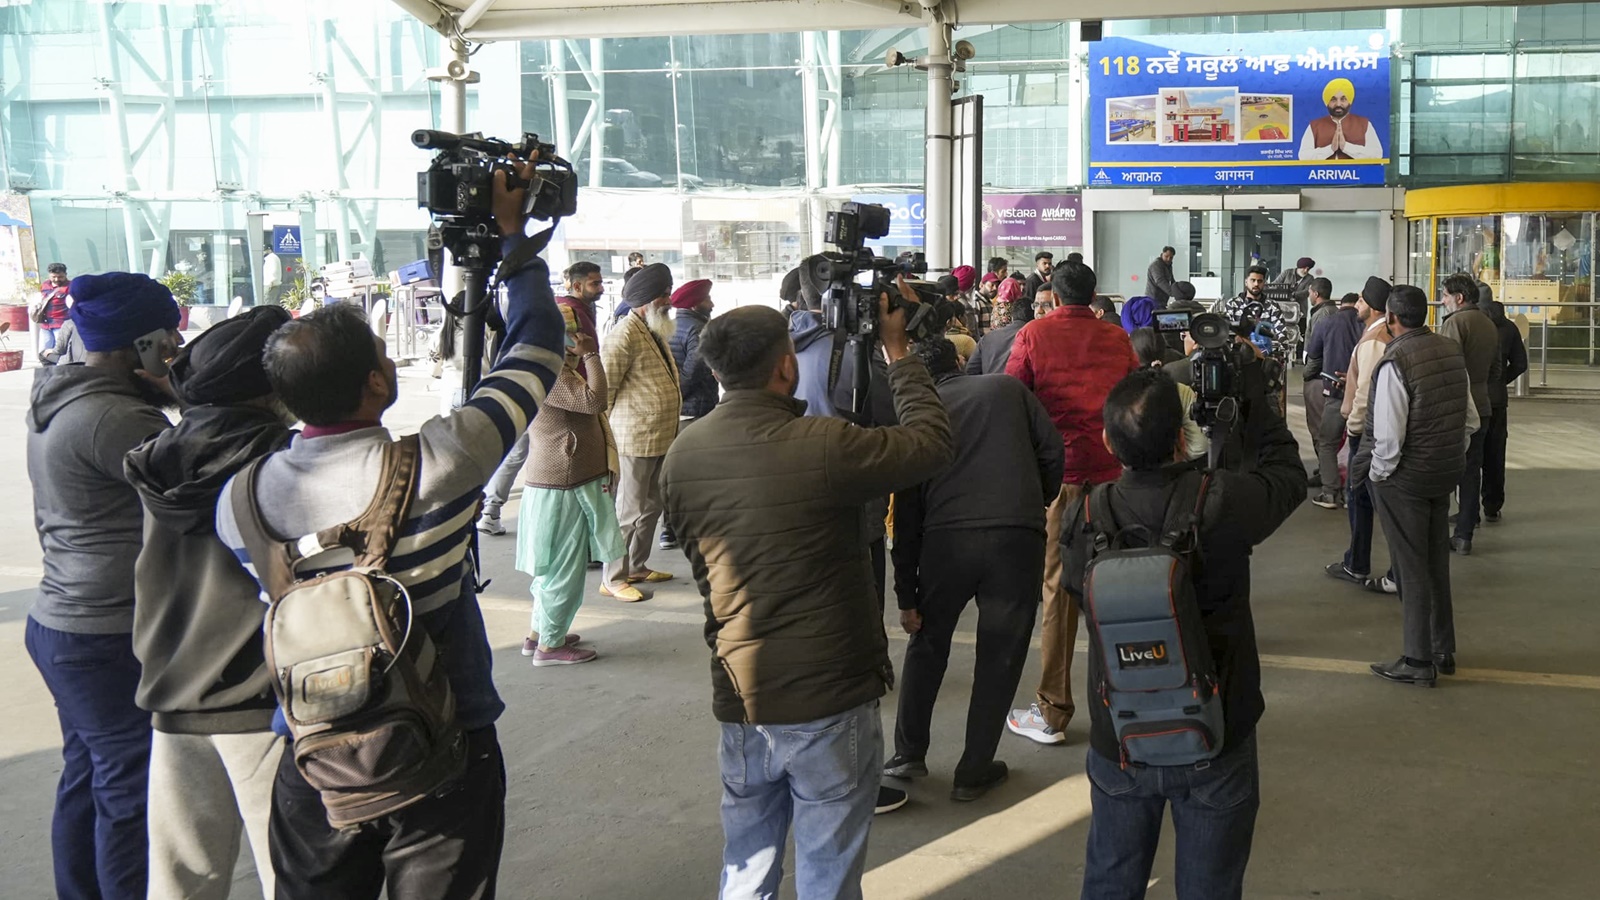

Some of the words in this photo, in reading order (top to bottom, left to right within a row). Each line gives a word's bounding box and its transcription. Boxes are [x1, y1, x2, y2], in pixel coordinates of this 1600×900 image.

[1099, 55, 1140, 75] 118
[1145, 50, 1181, 74] ਨਵੇਂ
[1185, 56, 1240, 80] ਸਕੂਲ
[1122, 171, 1163, 183] ਆਗਮਨ
[1214, 170, 1254, 181] आगमन
[1308, 169, 1360, 180] ARRIVAL
[1042, 203, 1076, 218] AVIAPRO
[1119, 644, 1166, 662] LiveU
